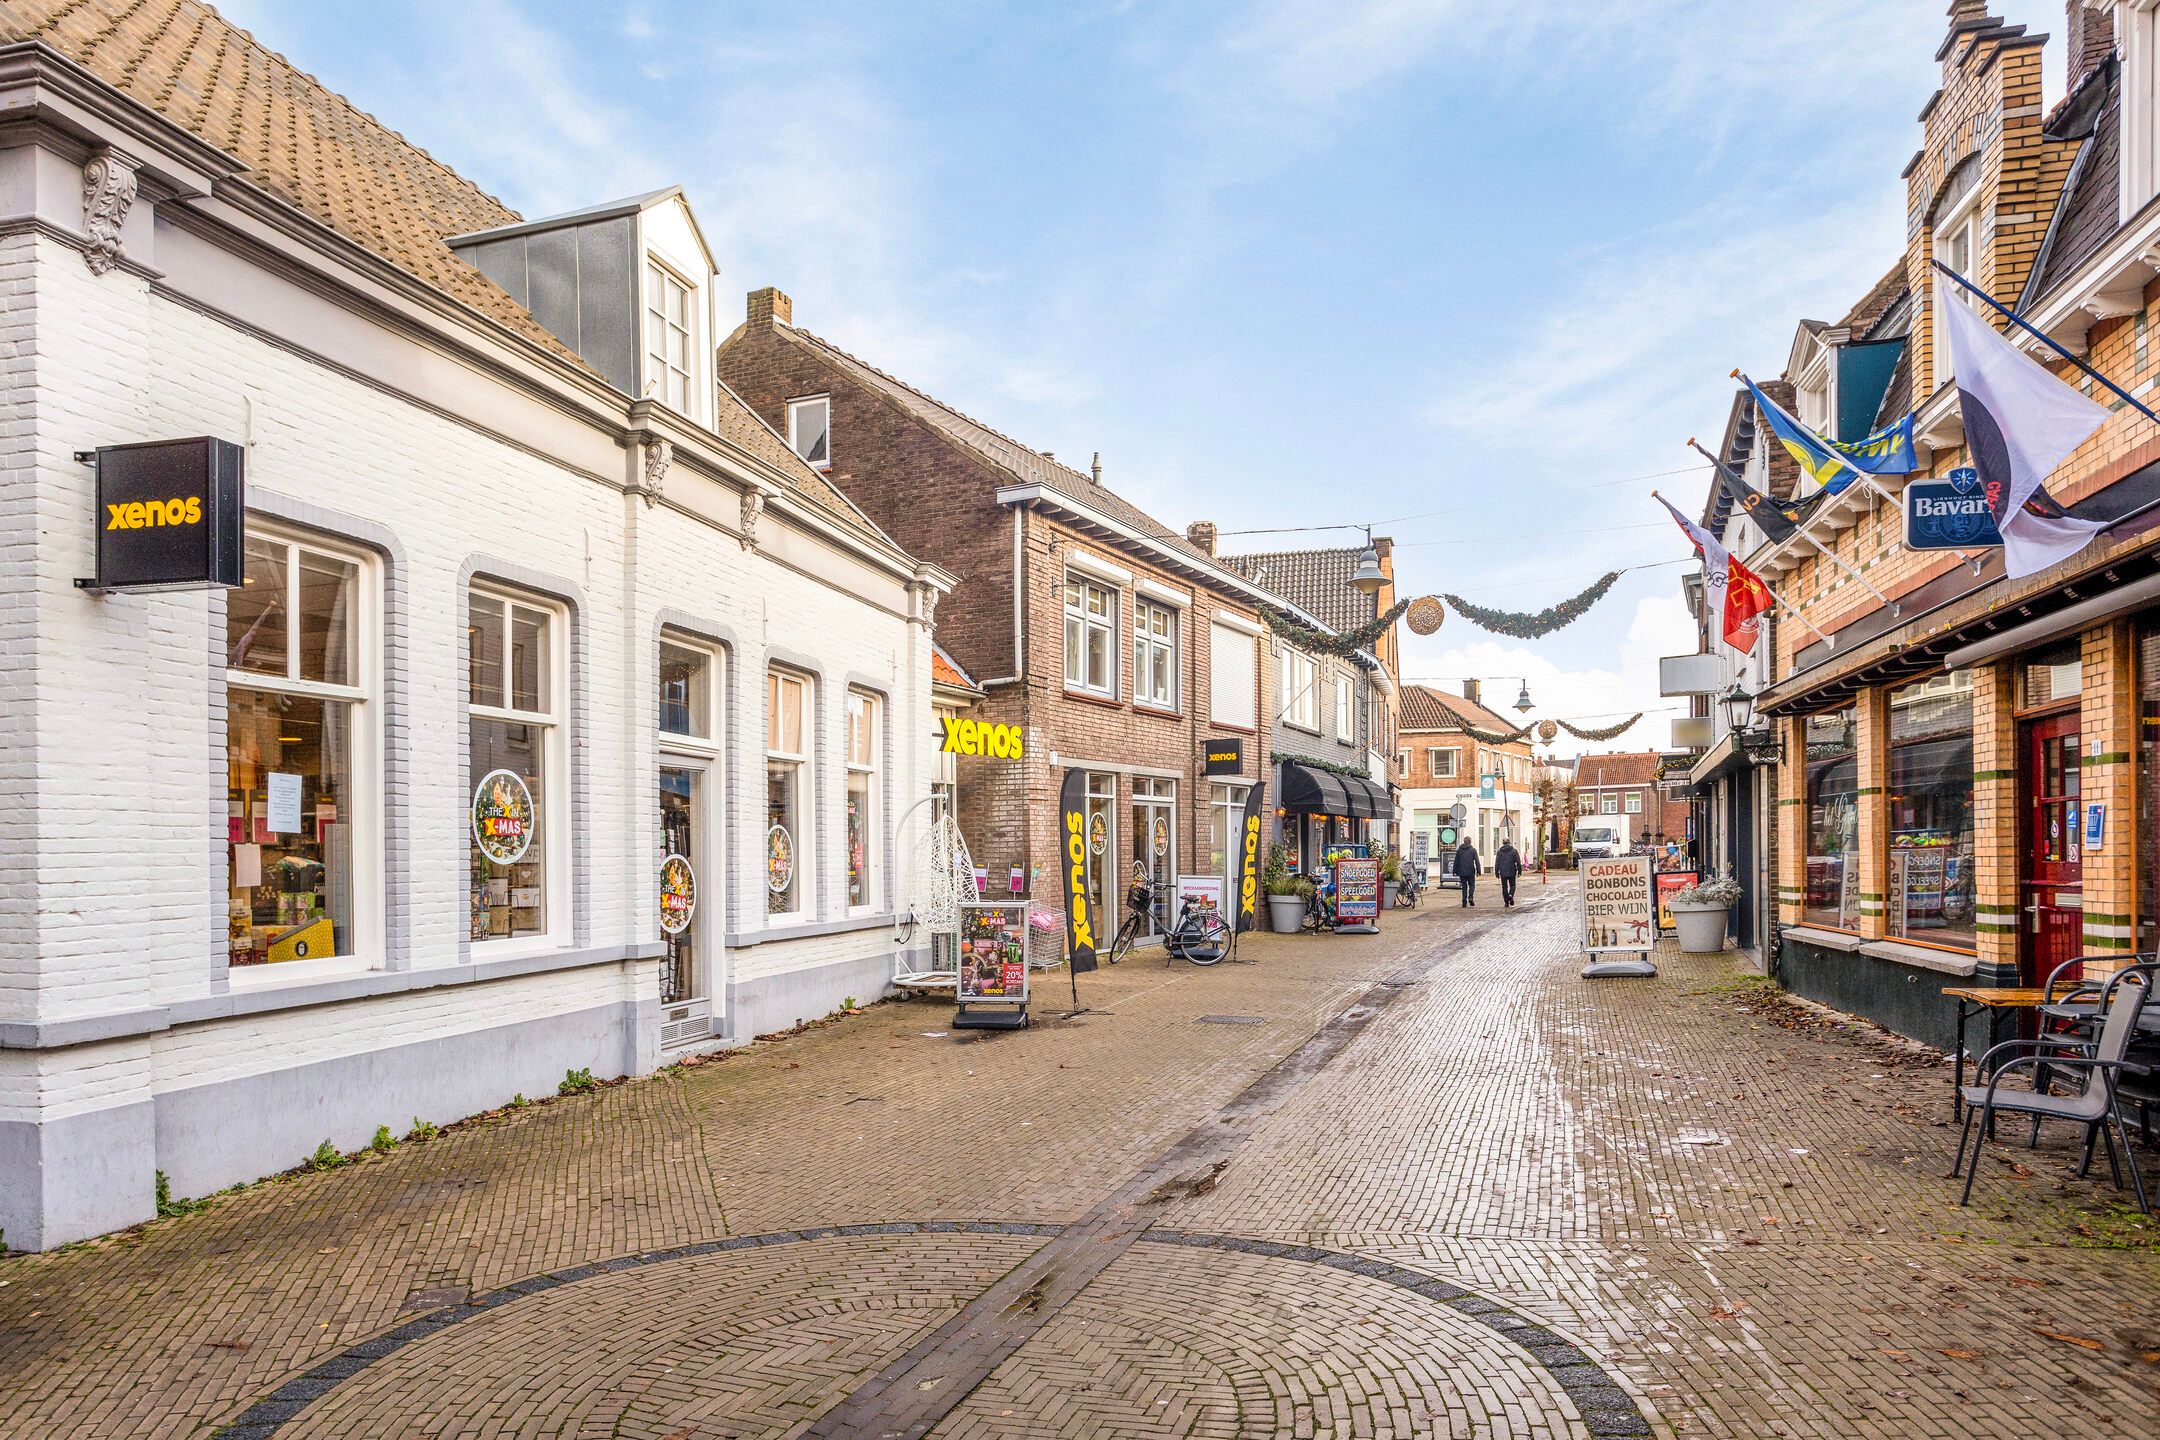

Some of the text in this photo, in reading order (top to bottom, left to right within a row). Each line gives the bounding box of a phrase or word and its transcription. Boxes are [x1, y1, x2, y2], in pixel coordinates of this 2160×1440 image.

[106, 496, 202, 530] xenos
[1914, 498, 1992, 517] Bavar
[941, 716, 1023, 760] xenos
[1208, 752, 1237, 762] xenos
[489, 804, 519, 819] THE X IN
[484, 817, 522, 837] X-MAS
[1241, 815, 1261, 918] xenos
[1340, 868, 1375, 877] SNOEPGOED
[1589, 863, 1638, 877] CADEAU
[1066, 810, 1094, 951] xenos
[1587, 877, 1646, 889] BONBONS
[1340, 886, 1375, 896] SPEELGOED
[1586, 890, 1647, 901] CHOCOLADE
[661, 893, 687, 910] X-MAS
[1588, 902, 1648, 916] BIER WIJN
[980, 917, 1006, 926] X-MAS
[1006, 971, 1024, 979] 20%
